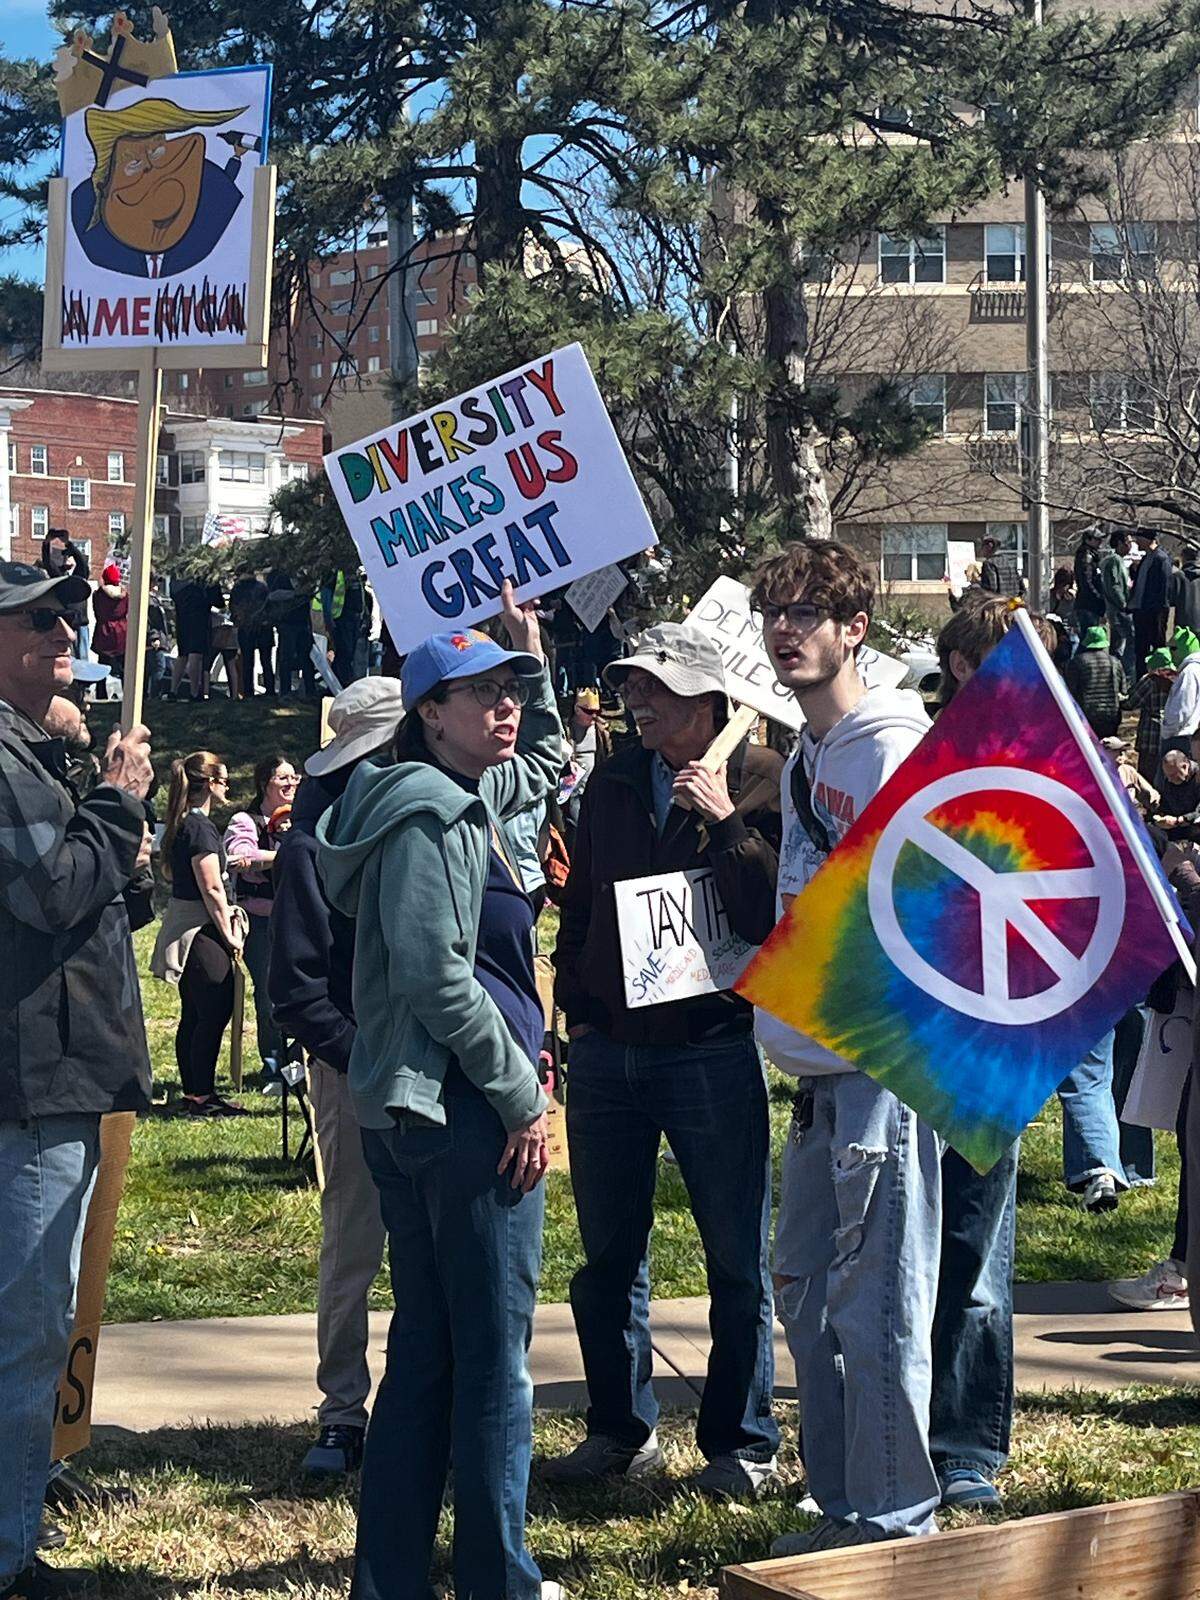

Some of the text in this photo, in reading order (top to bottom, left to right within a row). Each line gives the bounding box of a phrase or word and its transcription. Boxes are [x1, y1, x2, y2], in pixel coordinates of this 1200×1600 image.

[338, 359, 565, 504] DIVERSITY
[370, 430, 578, 568] MAKES US
[421, 500, 572, 619] GREAT
[632, 951, 667, 1000] SAVE
[636, 887, 700, 950] TAX
